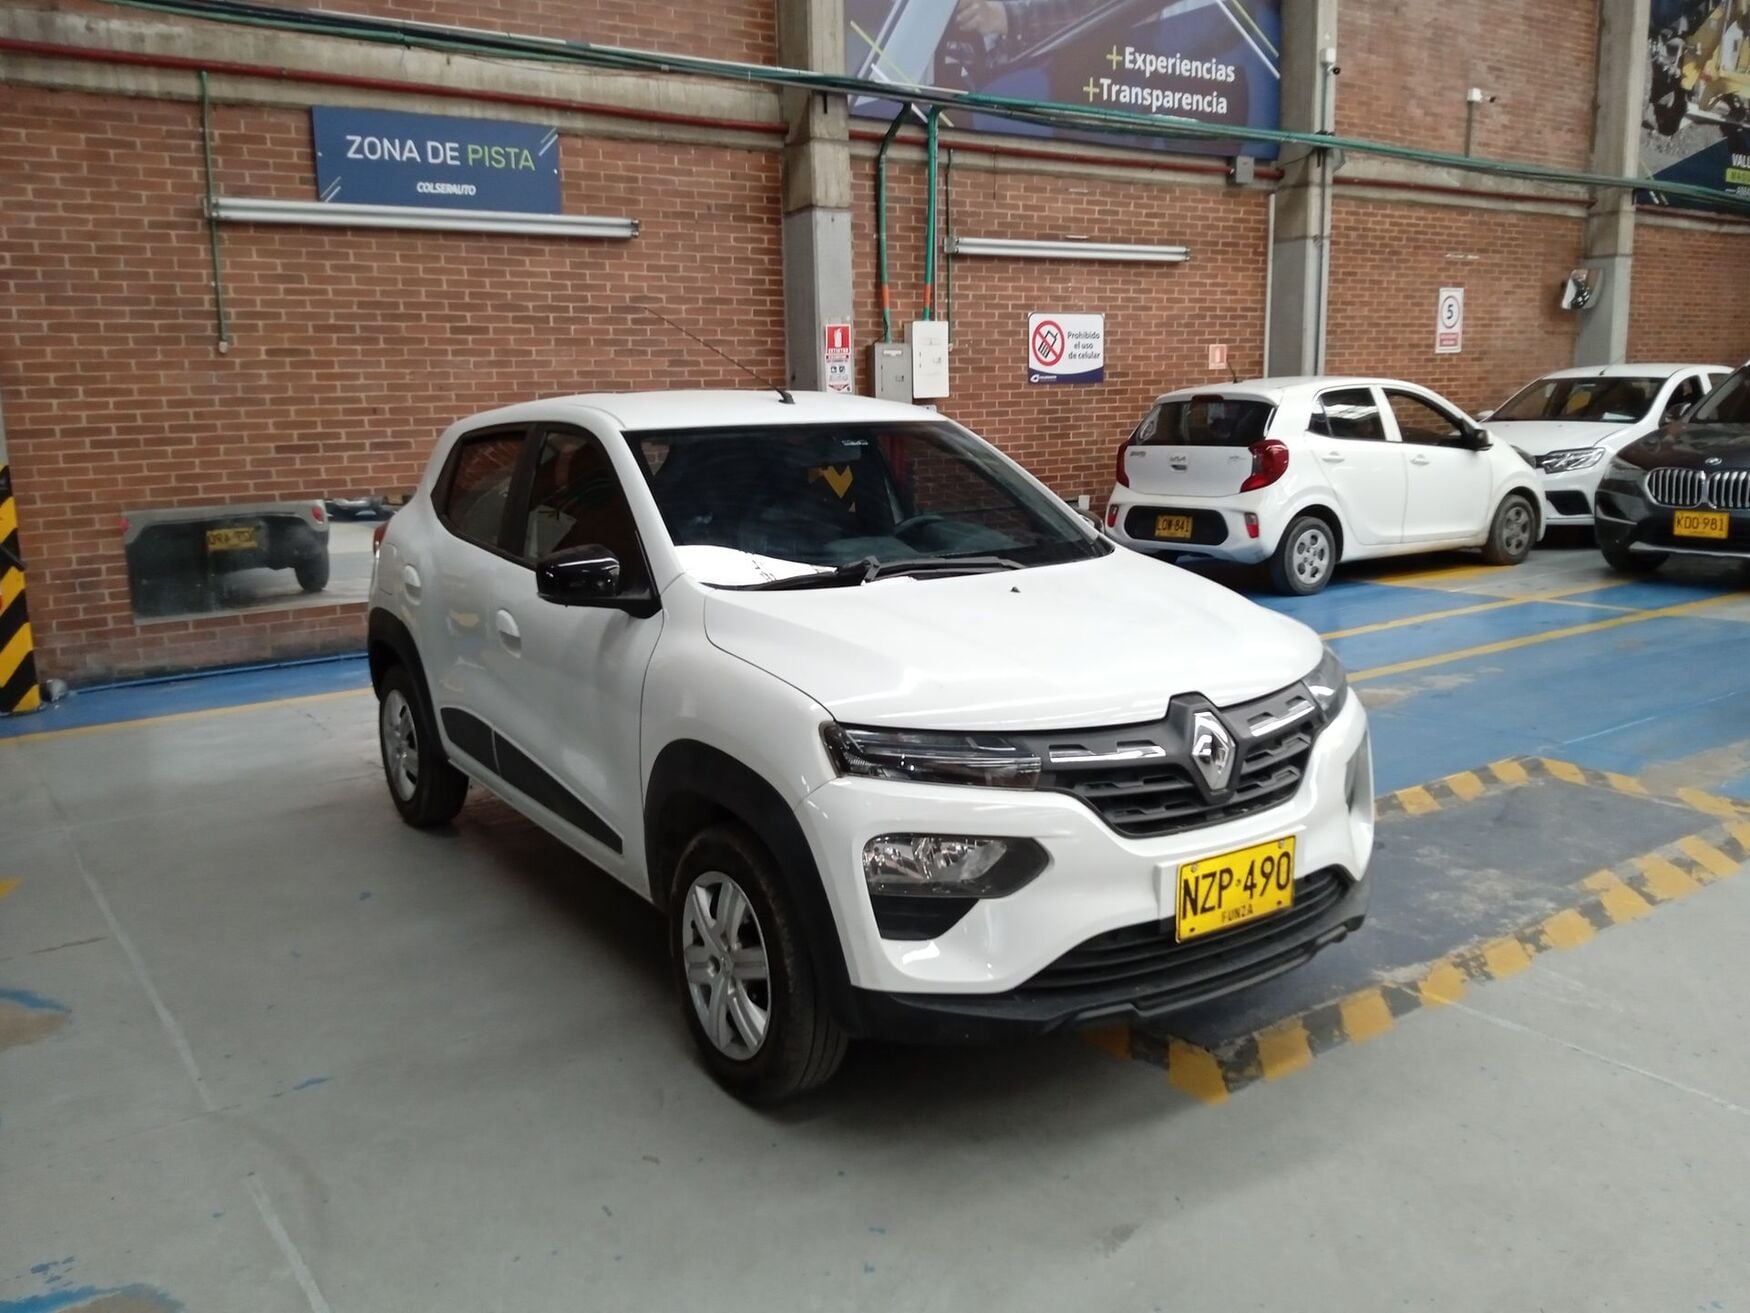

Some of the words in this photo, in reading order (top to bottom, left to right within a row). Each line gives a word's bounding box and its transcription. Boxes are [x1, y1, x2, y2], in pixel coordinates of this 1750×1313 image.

[346, 135, 421, 163] ZONA
[427, 140, 461, 166] DE
[467, 144, 536, 171] PISTA
[416, 181, 477, 196] COLSERAUTO
[1446, 303, 1454, 320] 5
[1067, 331, 1100, 339] Prohibido
[1074, 341, 1080, 349] el
[1068, 351, 1077, 359] de
[1078, 351, 1100, 359] celular
[1221, 904, 1254, 923] FUNZA
